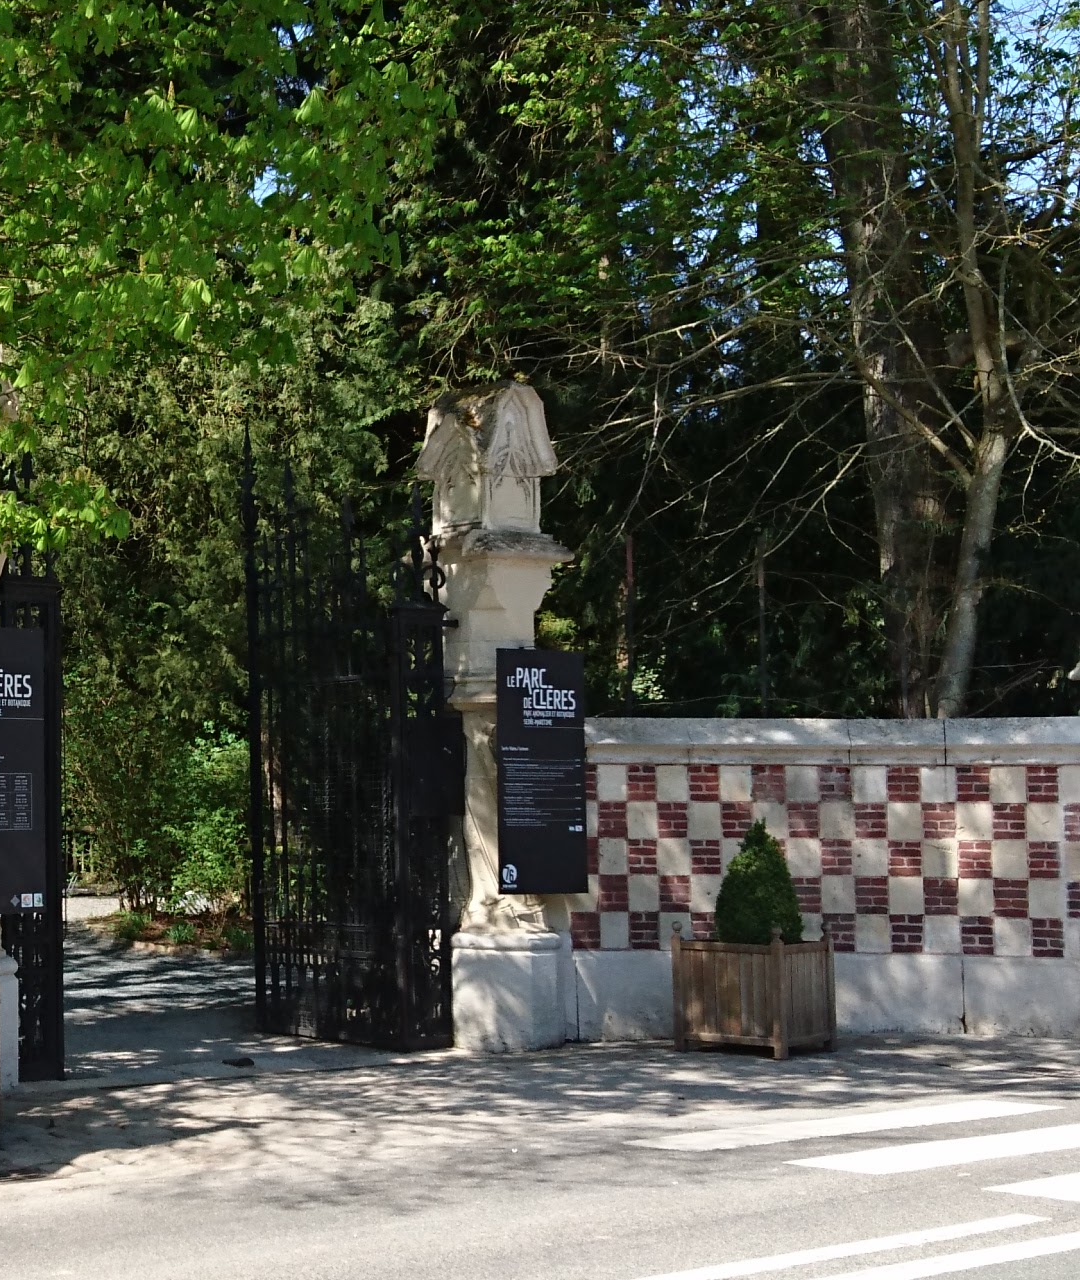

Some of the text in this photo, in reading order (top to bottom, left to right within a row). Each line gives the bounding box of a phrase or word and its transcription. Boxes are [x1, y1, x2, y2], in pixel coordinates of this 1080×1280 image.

[506, 667, 548, 695] LE PARC
[1, 699, 7, 707] ET
[7, 699, 32, 709] BOTANIQUE
[523, 697, 533, 709] DE
